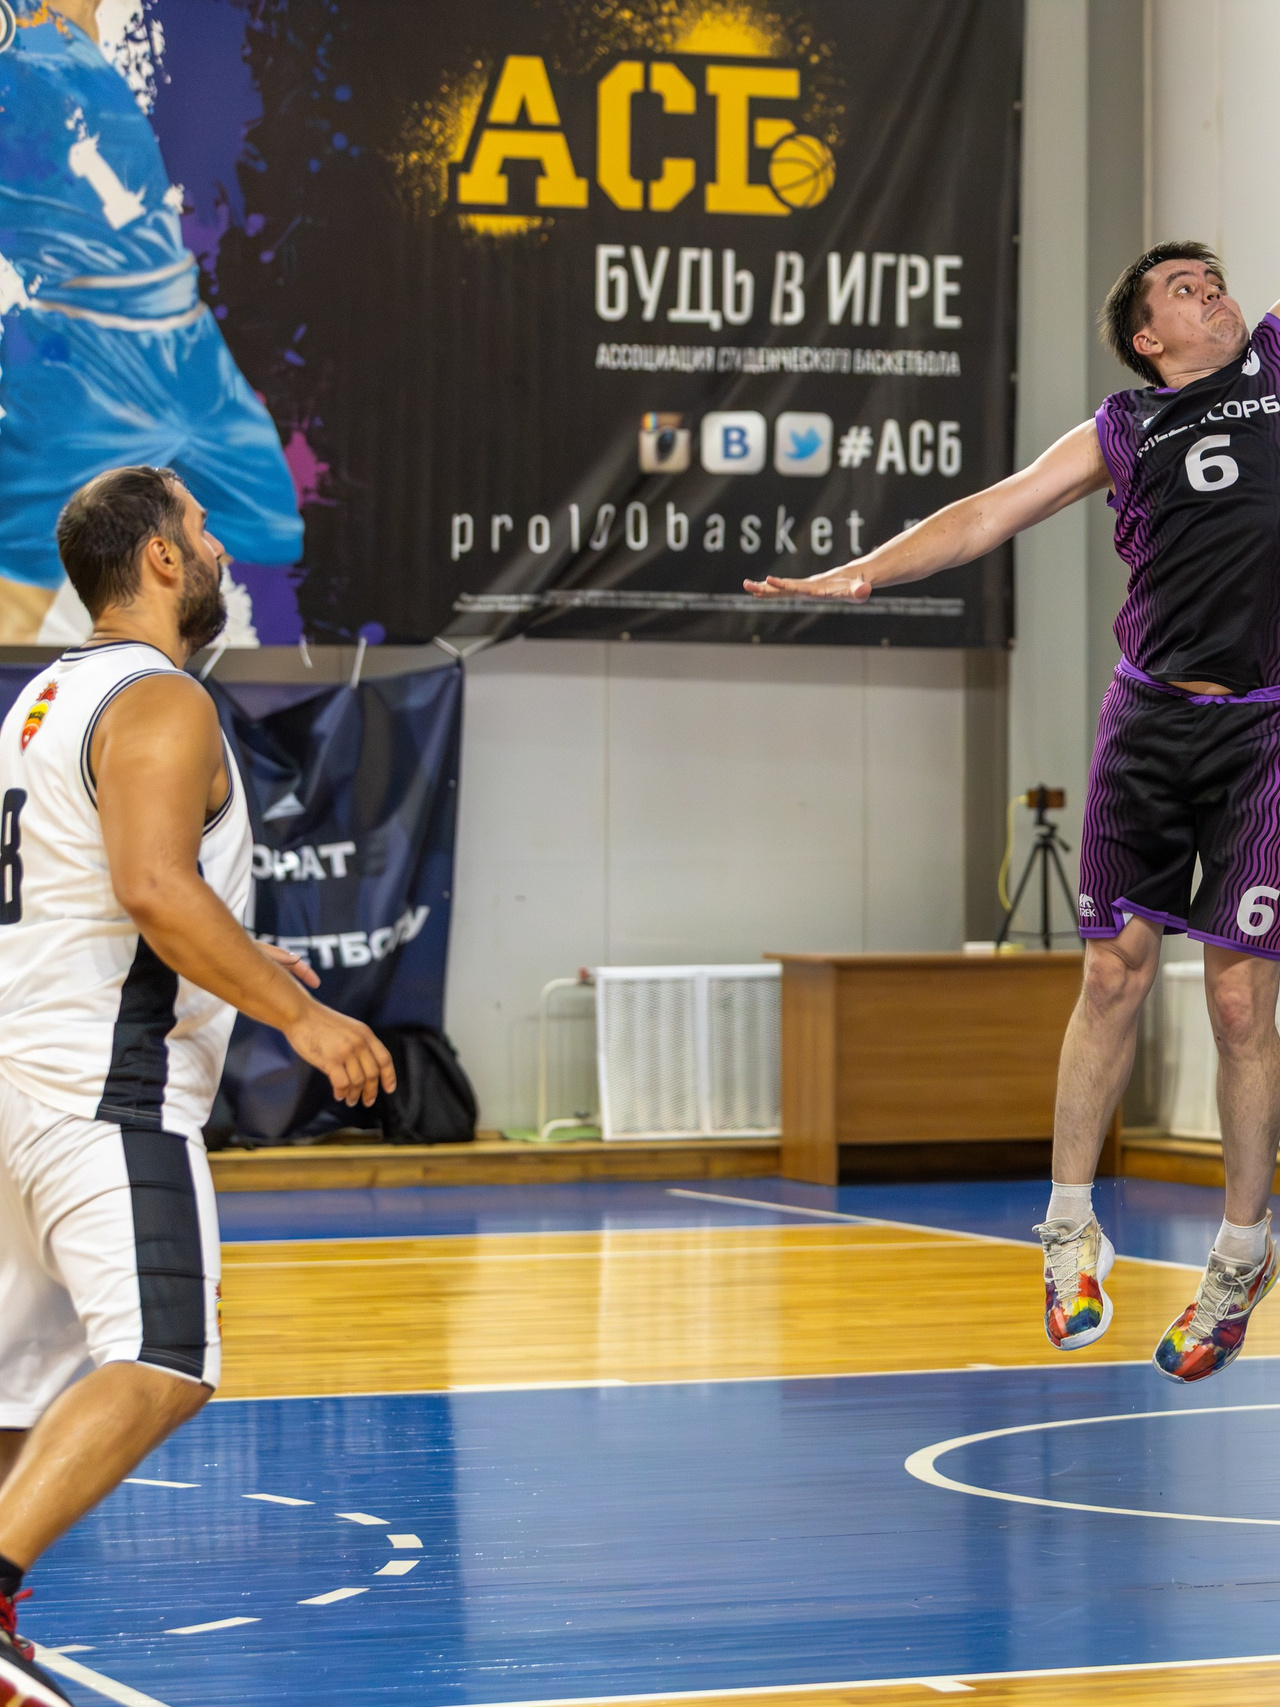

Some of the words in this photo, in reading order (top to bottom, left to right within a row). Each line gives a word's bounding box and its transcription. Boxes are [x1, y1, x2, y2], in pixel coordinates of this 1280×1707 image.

[457, 54, 836, 217] АСБ
[595, 244, 755, 332] БУДЬ
[770, 250, 805, 327] В
[826, 251, 964, 330] ИГРЕ
[838, 419, 963, 477] #АСБ
[1184, 433, 1240, 492] 6
[1235, 885, 1280, 937] 6
